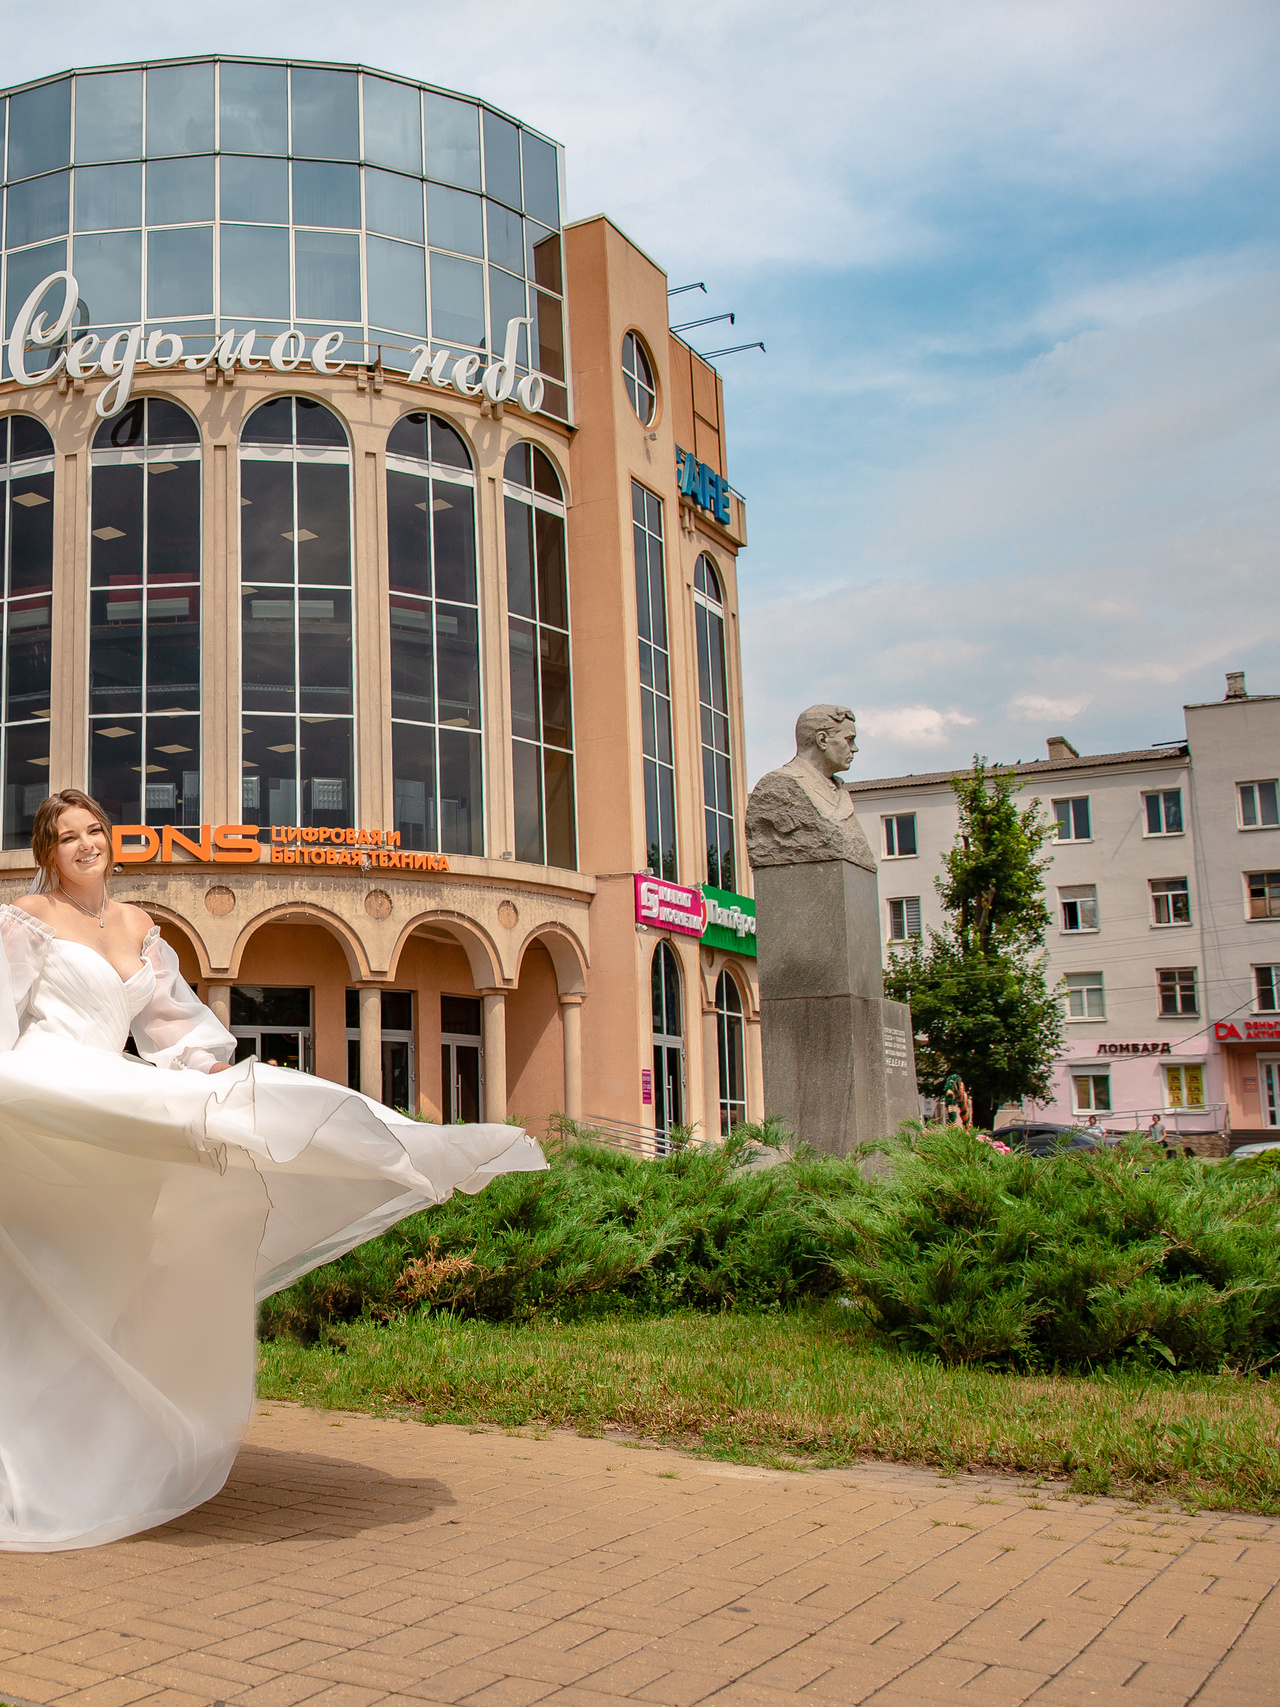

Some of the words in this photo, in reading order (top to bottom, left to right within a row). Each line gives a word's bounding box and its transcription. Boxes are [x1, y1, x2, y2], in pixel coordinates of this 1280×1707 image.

[406, 317, 545, 413] небо
[111, 824, 262, 863] DNS
[271, 824, 383, 846] ЦИФРОВАЯ
[387, 830, 401, 847] И
[271, 846, 364, 866] БЫТОВАЯ
[366, 849, 450, 872] ТЕХНИКА
[1097, 1042, 1172, 1055] ЛОМБАРД
